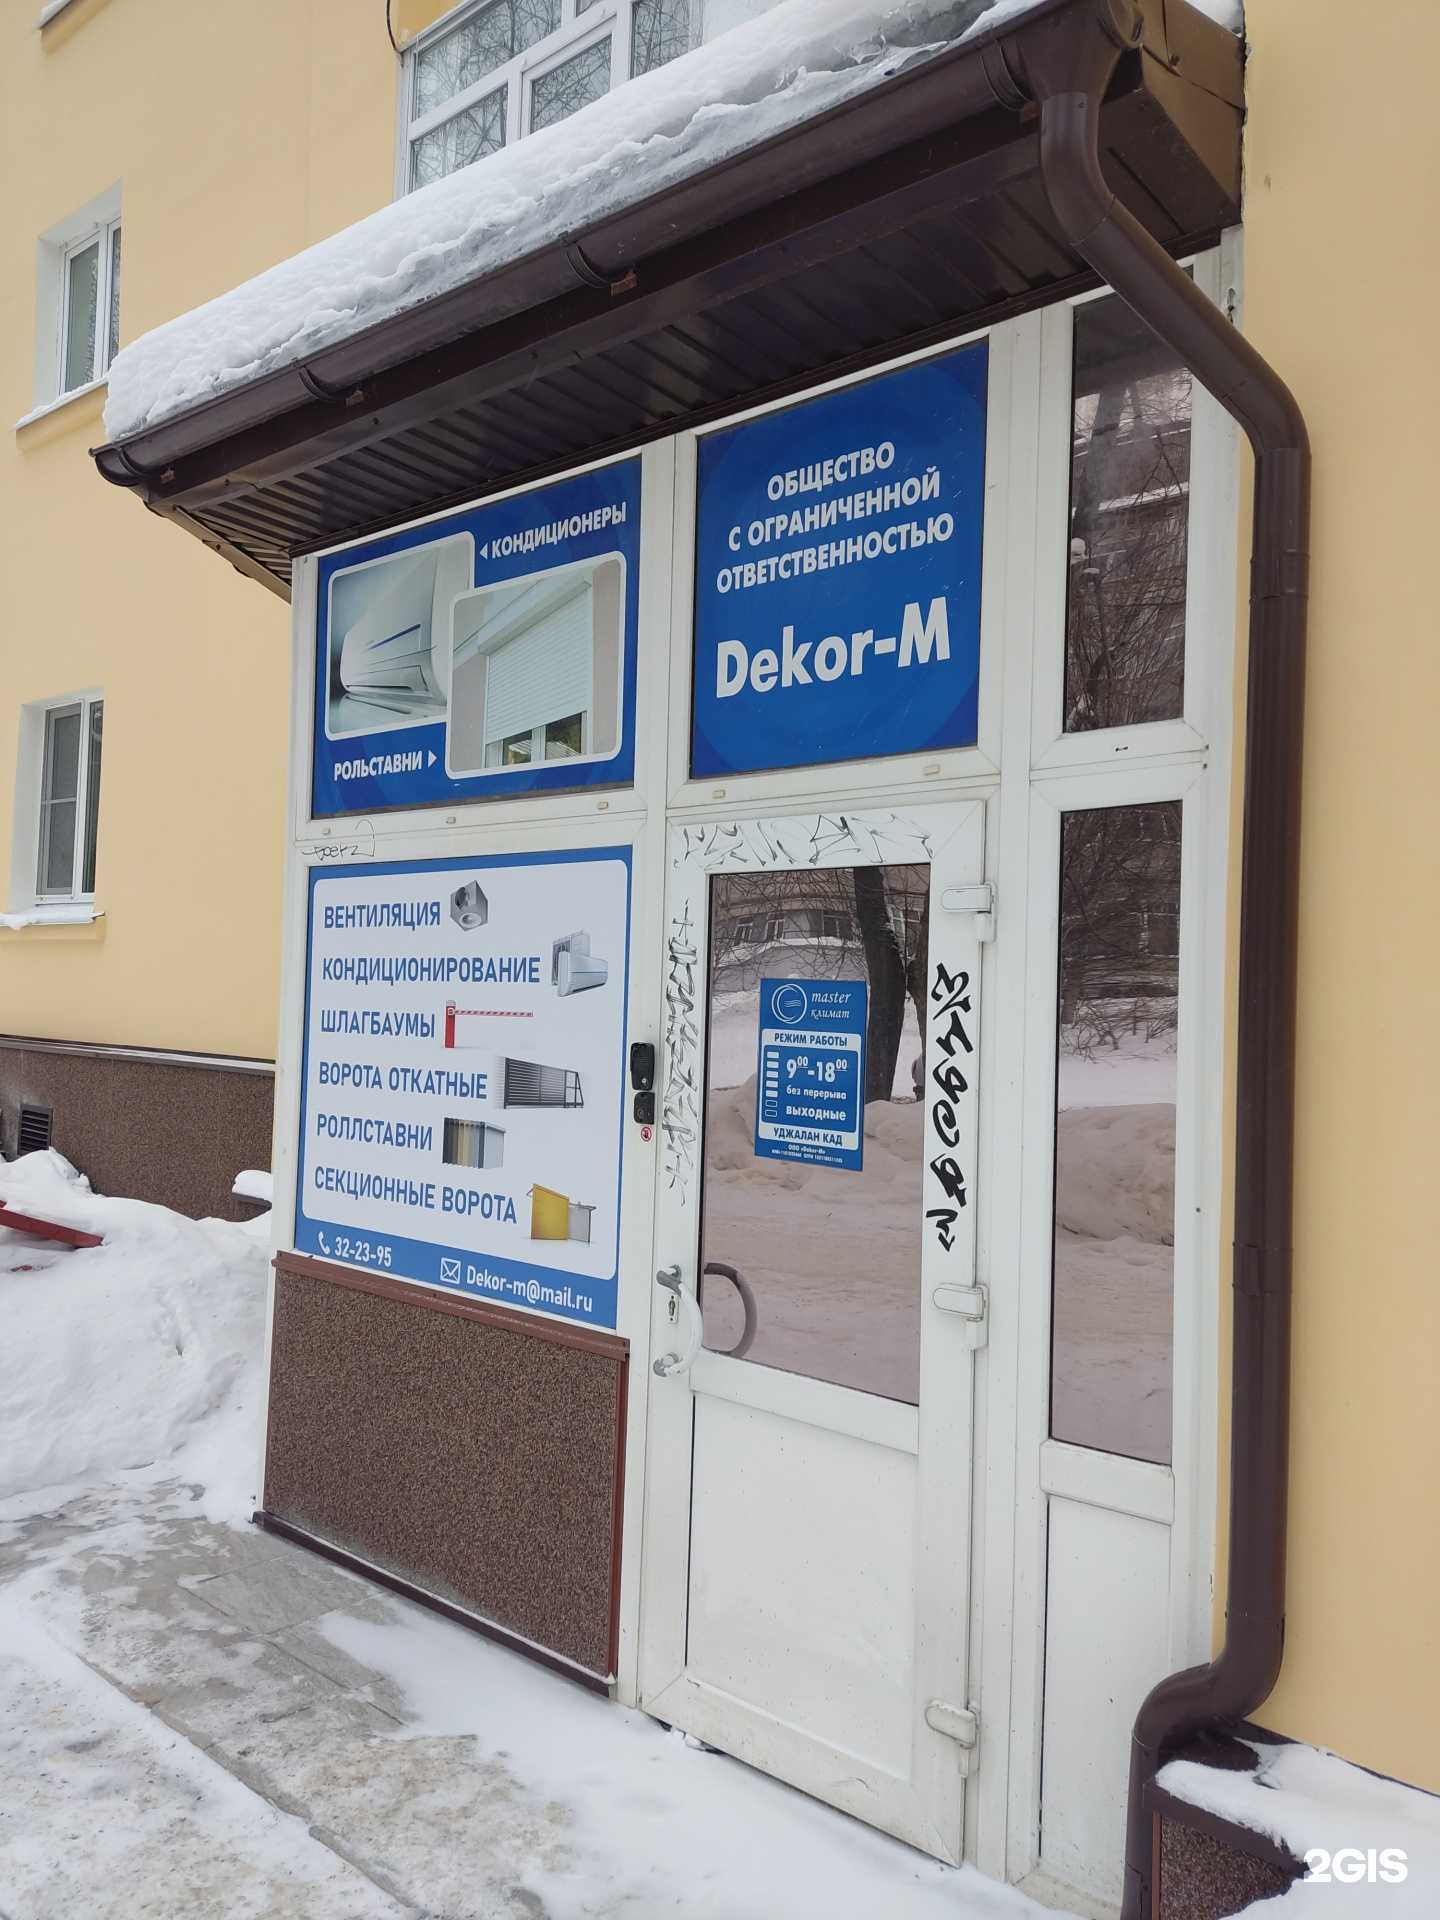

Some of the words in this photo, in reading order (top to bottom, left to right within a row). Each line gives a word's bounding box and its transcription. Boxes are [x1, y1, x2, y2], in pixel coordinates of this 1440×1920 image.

[767, 441, 895, 500] ОБЩЕСТВО
[728, 526, 742, 551] С
[748, 465, 940, 547] ОГРАНИЧЕННОЙ
[491, 501, 627, 559] КОНДИЦИОНЕРЫ
[716, 513, 954, 594] ОТВЕТСТВЕННОСТЬЮ
[716, 596, 951, 698] Dekor-M
[333, 750, 423, 781] РОЛЬСТАВНИ
[324, 901, 441, 931] ВЕНТИЛЯЦИЯ
[322, 957, 541, 986] КОНДИЦИОНИРОВАНИЕ
[811, 991, 852, 1004] master
[320, 1009, 435, 1038] ШЛАГБАУМЫ
[774, 1032, 807, 1044] РЕЖИМ
[809, 1035, 848, 1047] РАБОТЫ
[319, 1061, 383, 1089] ВОРОТА
[388, 1067, 488, 1100] ОТКАТНЫЕ
[786, 1085, 801, 1096] без
[803, 1088, 847, 1100] перерыва
[317, 1113, 433, 1151] РОЛЛСТАВНИ
[773, 1127, 820, 1142] УДЖАЛАН
[822, 1133, 843, 1146] КАД
[315, 1166, 436, 1209] СЕКЦИОННЫЕ
[441, 1186, 517, 1224] ВОРОТА
[334, 1236, 392, 1268] 32-23-95
[466, 1265, 593, 1313] Dekor-m@mail.ru
